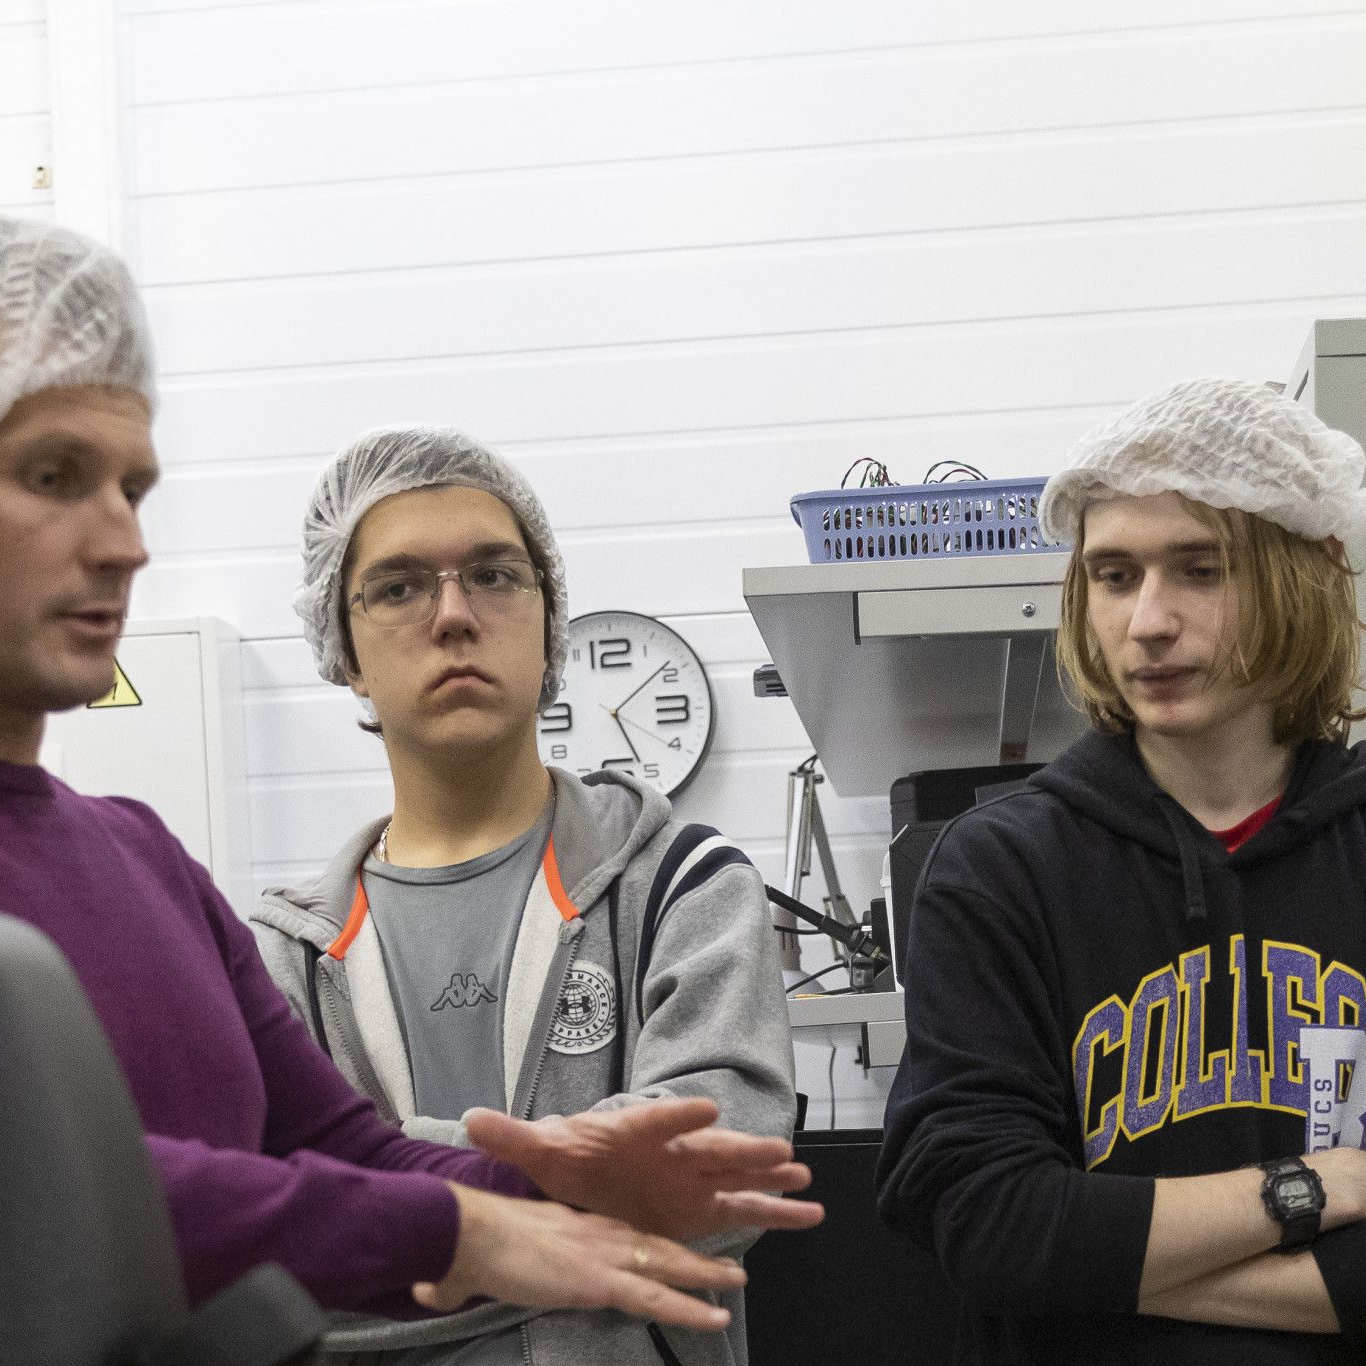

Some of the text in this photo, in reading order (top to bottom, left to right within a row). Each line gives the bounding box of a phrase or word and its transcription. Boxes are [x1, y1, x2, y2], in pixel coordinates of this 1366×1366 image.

[590, 638, 633, 670] 12
[663, 668, 679, 683] 2
[655, 694, 691, 726] 3
[668, 737, 682, 750] 4
[551, 744, 568, 760] 8
[643, 763, 660, 779] 5
